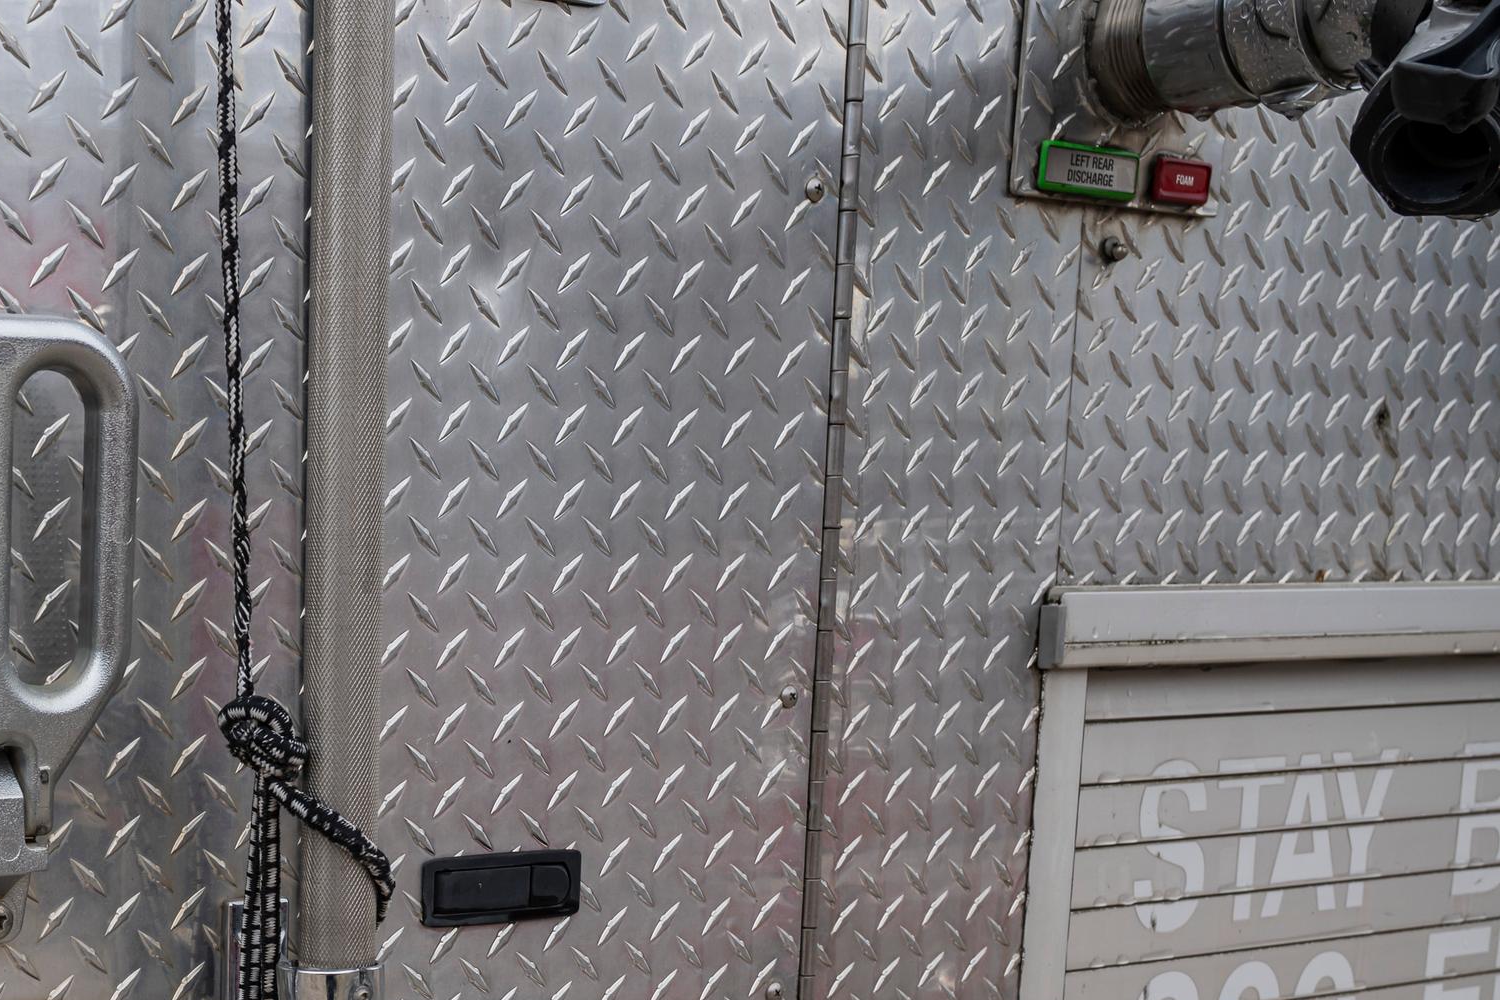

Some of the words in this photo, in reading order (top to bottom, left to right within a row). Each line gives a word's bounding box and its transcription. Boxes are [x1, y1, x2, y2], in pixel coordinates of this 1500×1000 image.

[1070, 153, 1091, 167] LEFT
[1092, 157, 1115, 171] REAR
[1067, 169, 1113, 187] DISCHARGE
[1176, 174, 1194, 186] FOAM
[1132, 748, 1401, 933] STAY
